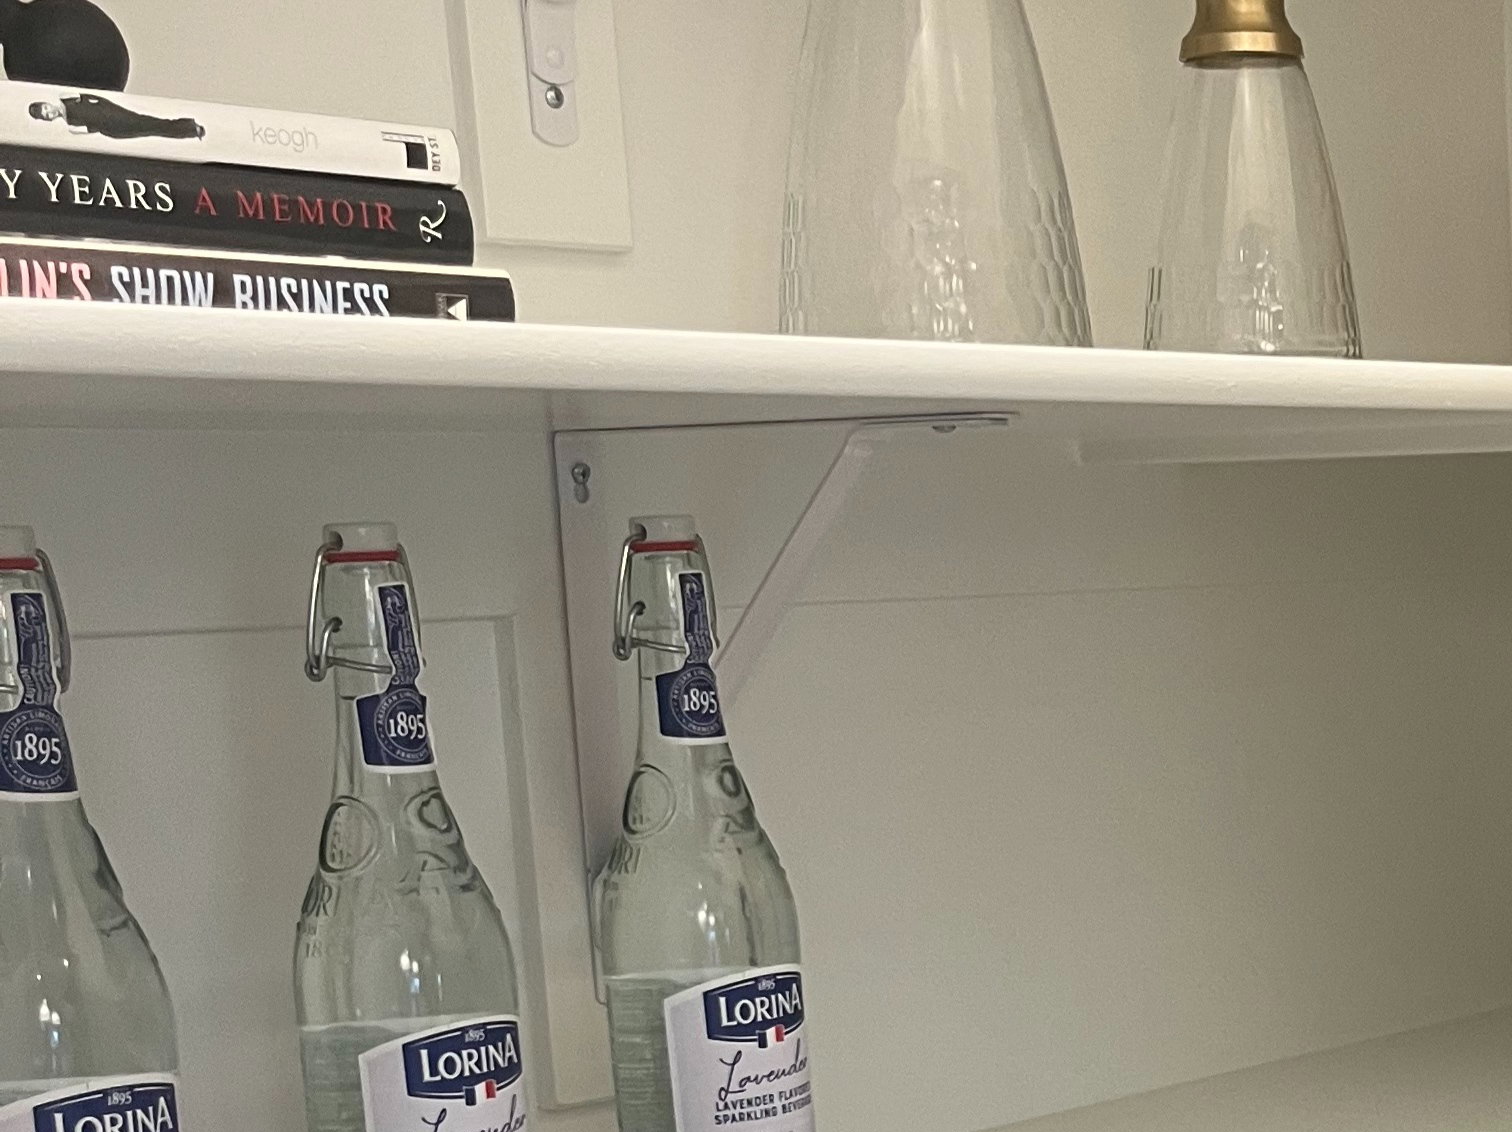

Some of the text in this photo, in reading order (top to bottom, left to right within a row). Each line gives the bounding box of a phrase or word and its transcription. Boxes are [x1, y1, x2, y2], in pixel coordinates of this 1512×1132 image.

[250, 121, 318, 153] keogh
[431, 151, 441, 172] DEY
[38, 171, 175, 213] YEARS
[194, 187, 218, 217] A
[235, 190, 397, 232] MEMOIR
[110, 265, 214, 309] SHOW
[232, 273, 390, 317] BUSINESS
[684, 687, 718, 715] 1895
[388, 711, 426, 740] 1895
[15, 732, 62, 765] 1895
[718, 982, 802, 1028] LORINA
[465, 1029, 485, 1043] 1895
[419, 1033, 518, 1084] LORINA
[717, 1037, 808, 1101] Lavender
[108, 1090, 133, 1107] 1895
[715, 1092, 775, 1113] LAVENDER
[714, 1108, 778, 1126] SPARKLING
